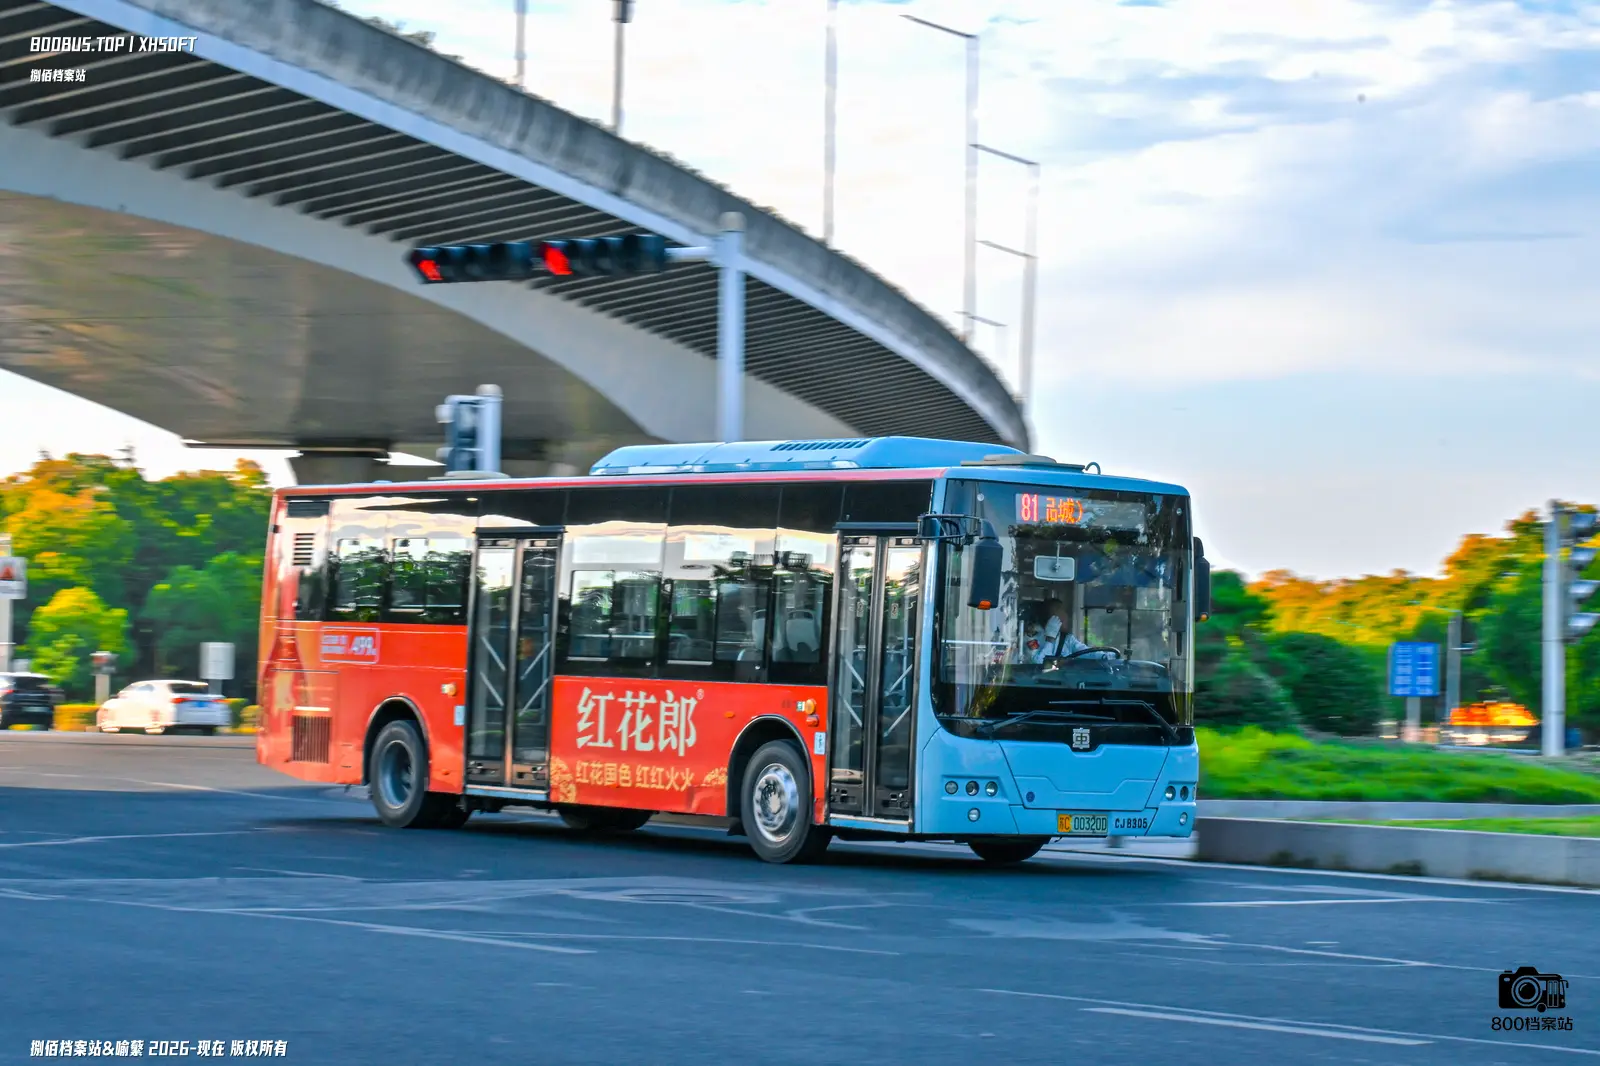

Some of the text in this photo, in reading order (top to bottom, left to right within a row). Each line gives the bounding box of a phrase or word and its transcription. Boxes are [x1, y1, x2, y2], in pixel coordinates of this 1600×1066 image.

[1021, 493, 1039, 522] 81
[576, 686, 698, 757] 红花郎
[575, 760, 695, 792] 红花国色 红红火火
